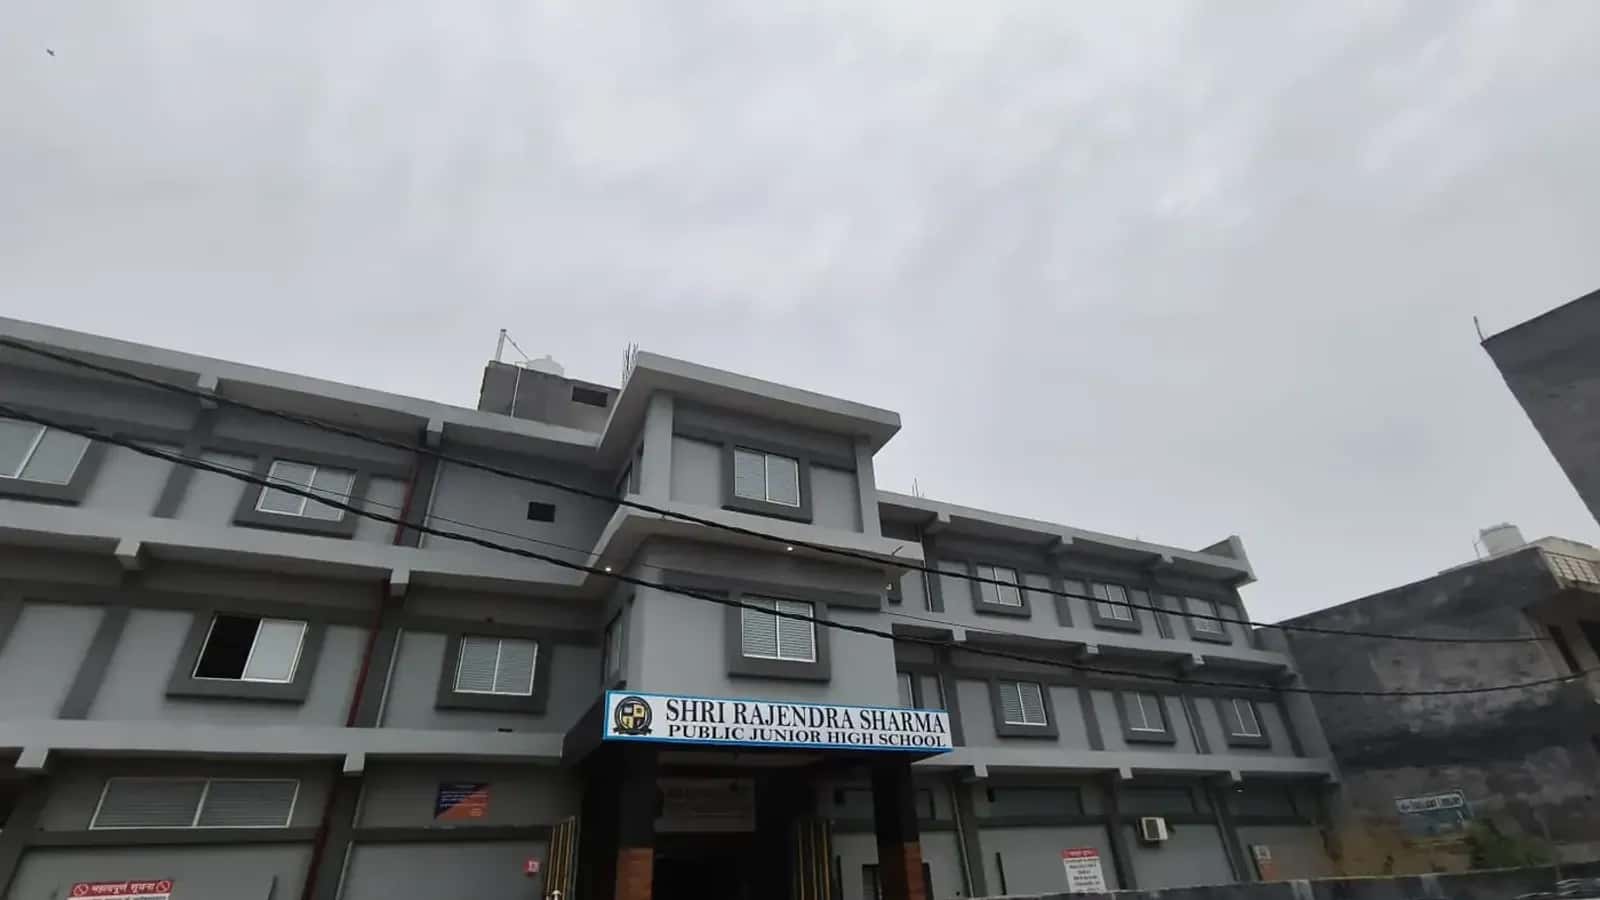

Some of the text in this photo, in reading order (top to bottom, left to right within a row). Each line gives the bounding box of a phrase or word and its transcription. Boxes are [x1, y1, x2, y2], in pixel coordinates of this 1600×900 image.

[665, 698, 946, 734] SHRI RAJENDRA SHARMA
[668, 724, 946, 747] PUBLIC JUNIOR HIGH SCHOOL
